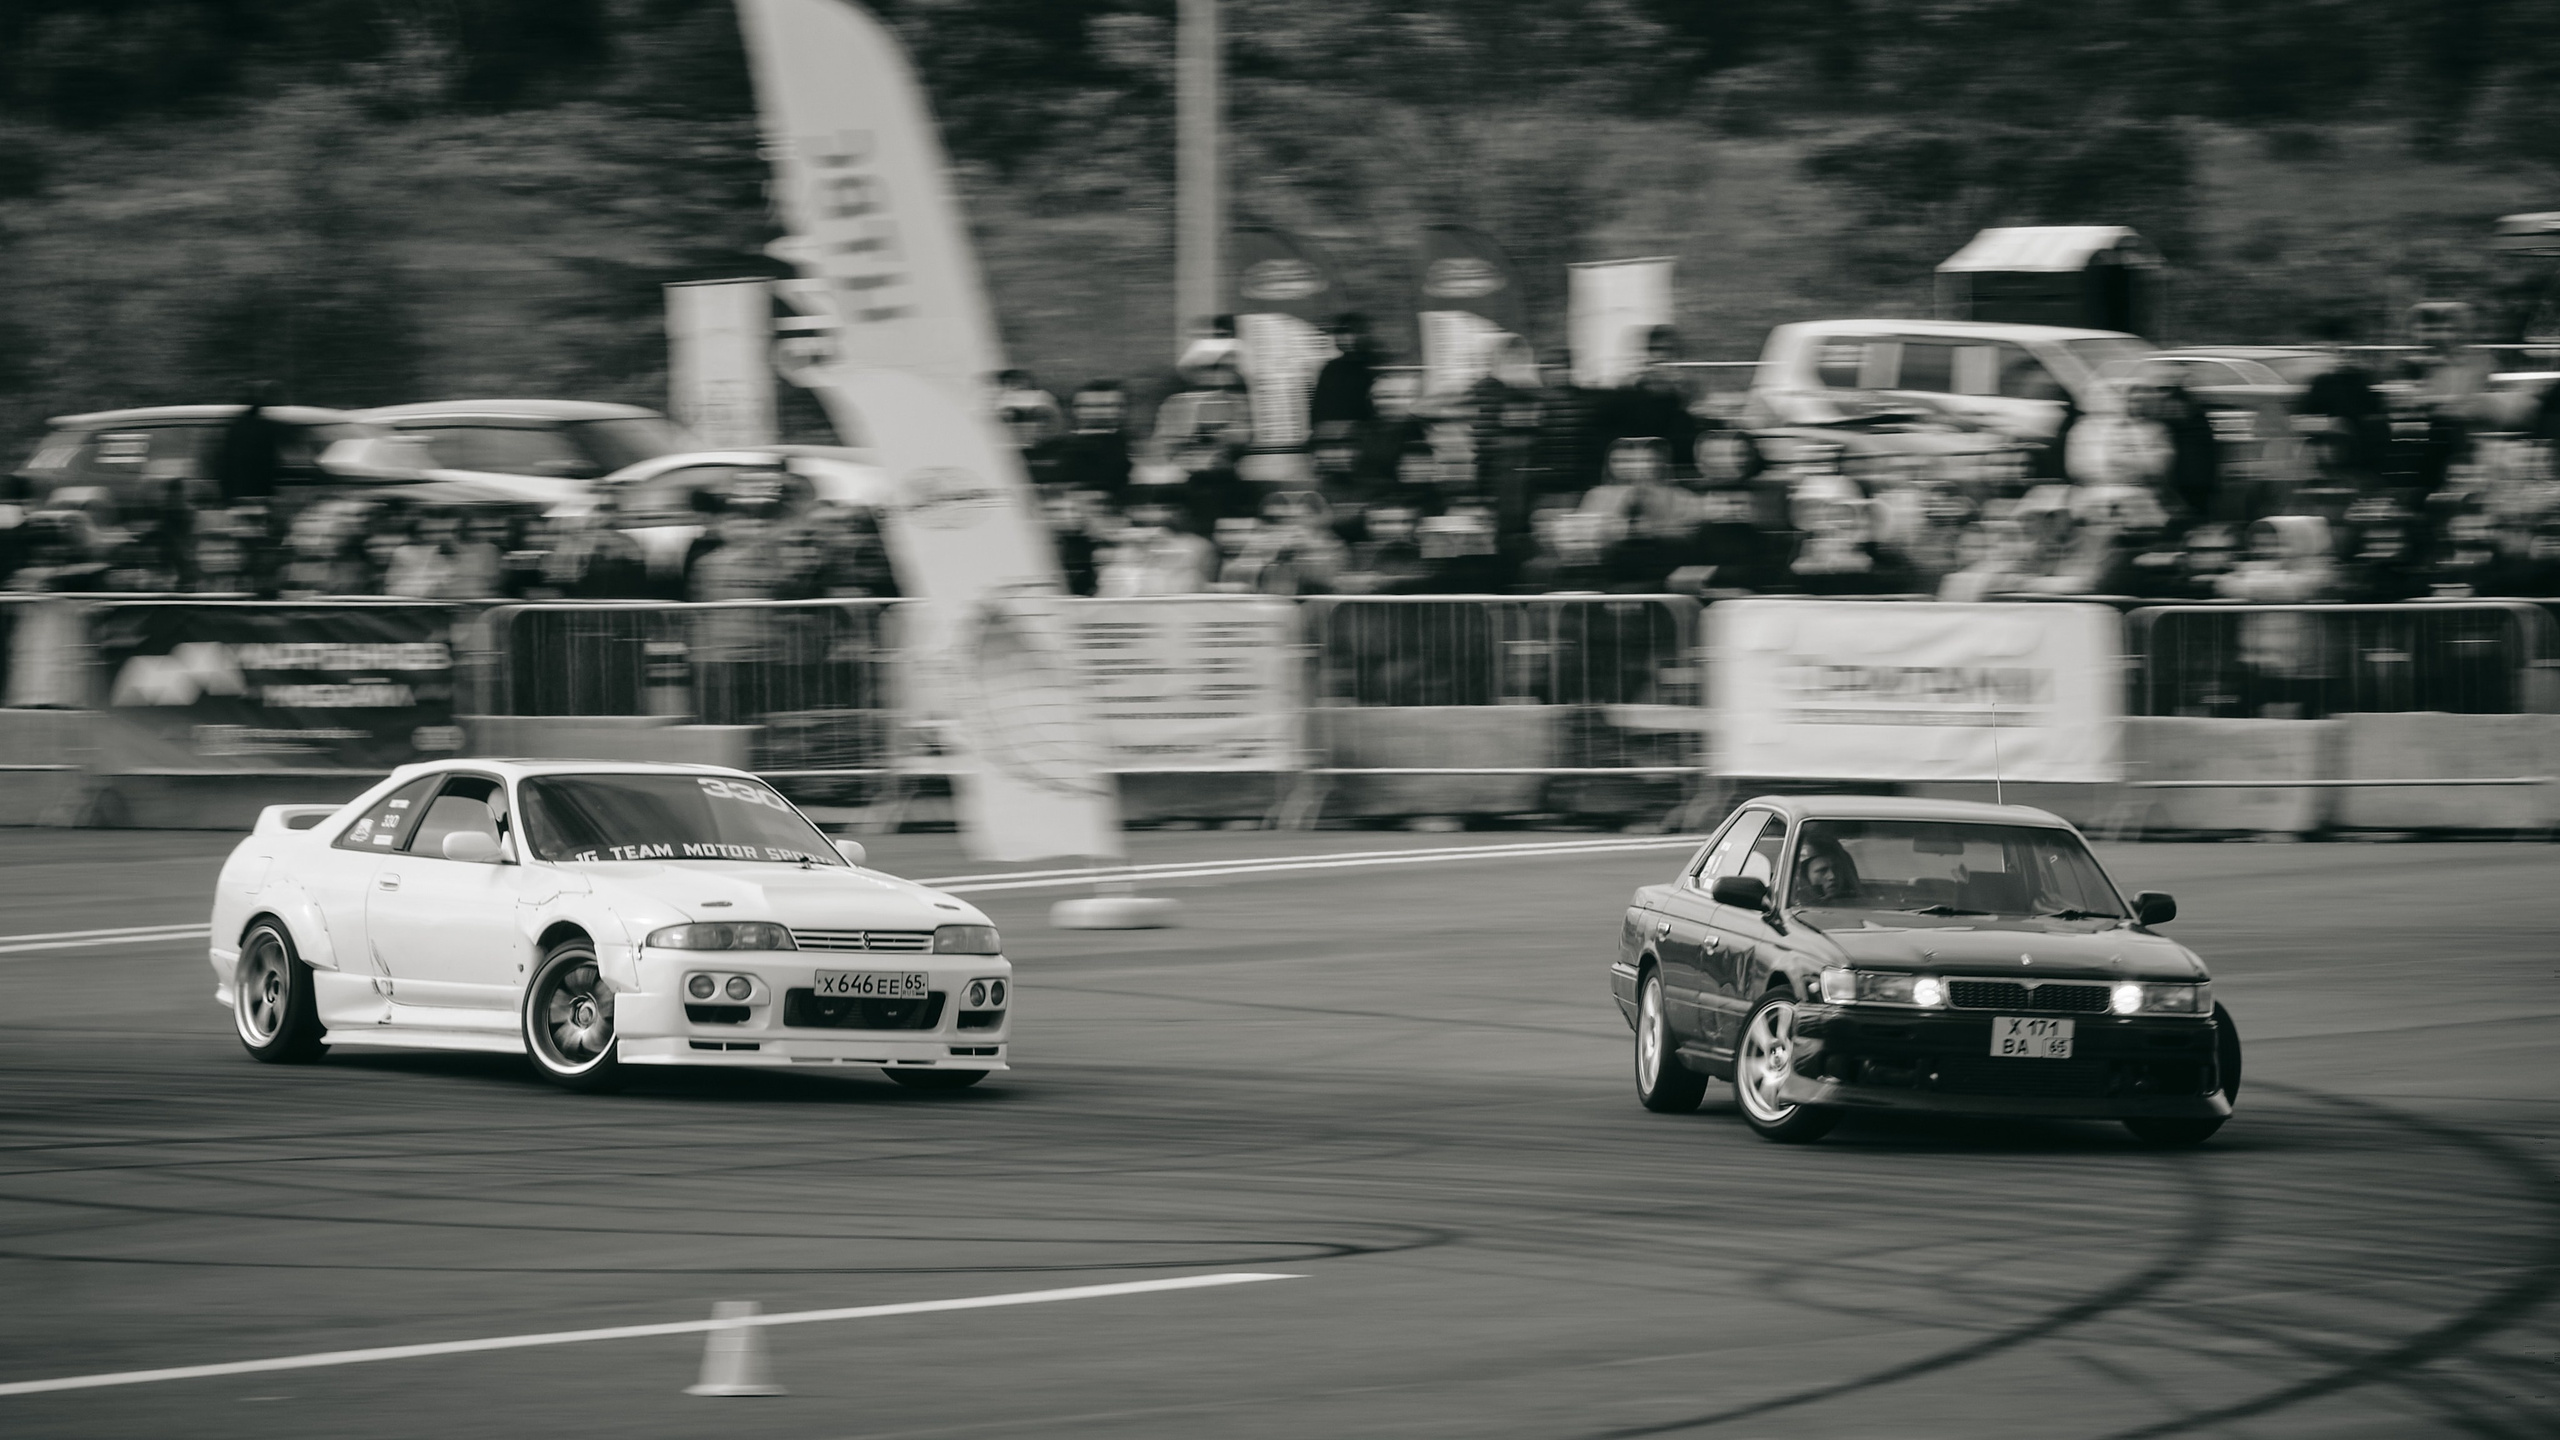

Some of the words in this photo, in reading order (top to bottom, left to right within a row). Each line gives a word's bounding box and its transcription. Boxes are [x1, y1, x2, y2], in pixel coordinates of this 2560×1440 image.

[697, 778, 790, 813] 330
[609, 843, 675, 861] TEAM
[682, 843, 759, 860] MOTOR
[905, 974, 922, 990] 65
[2027, 1019, 2059, 1036] 171
